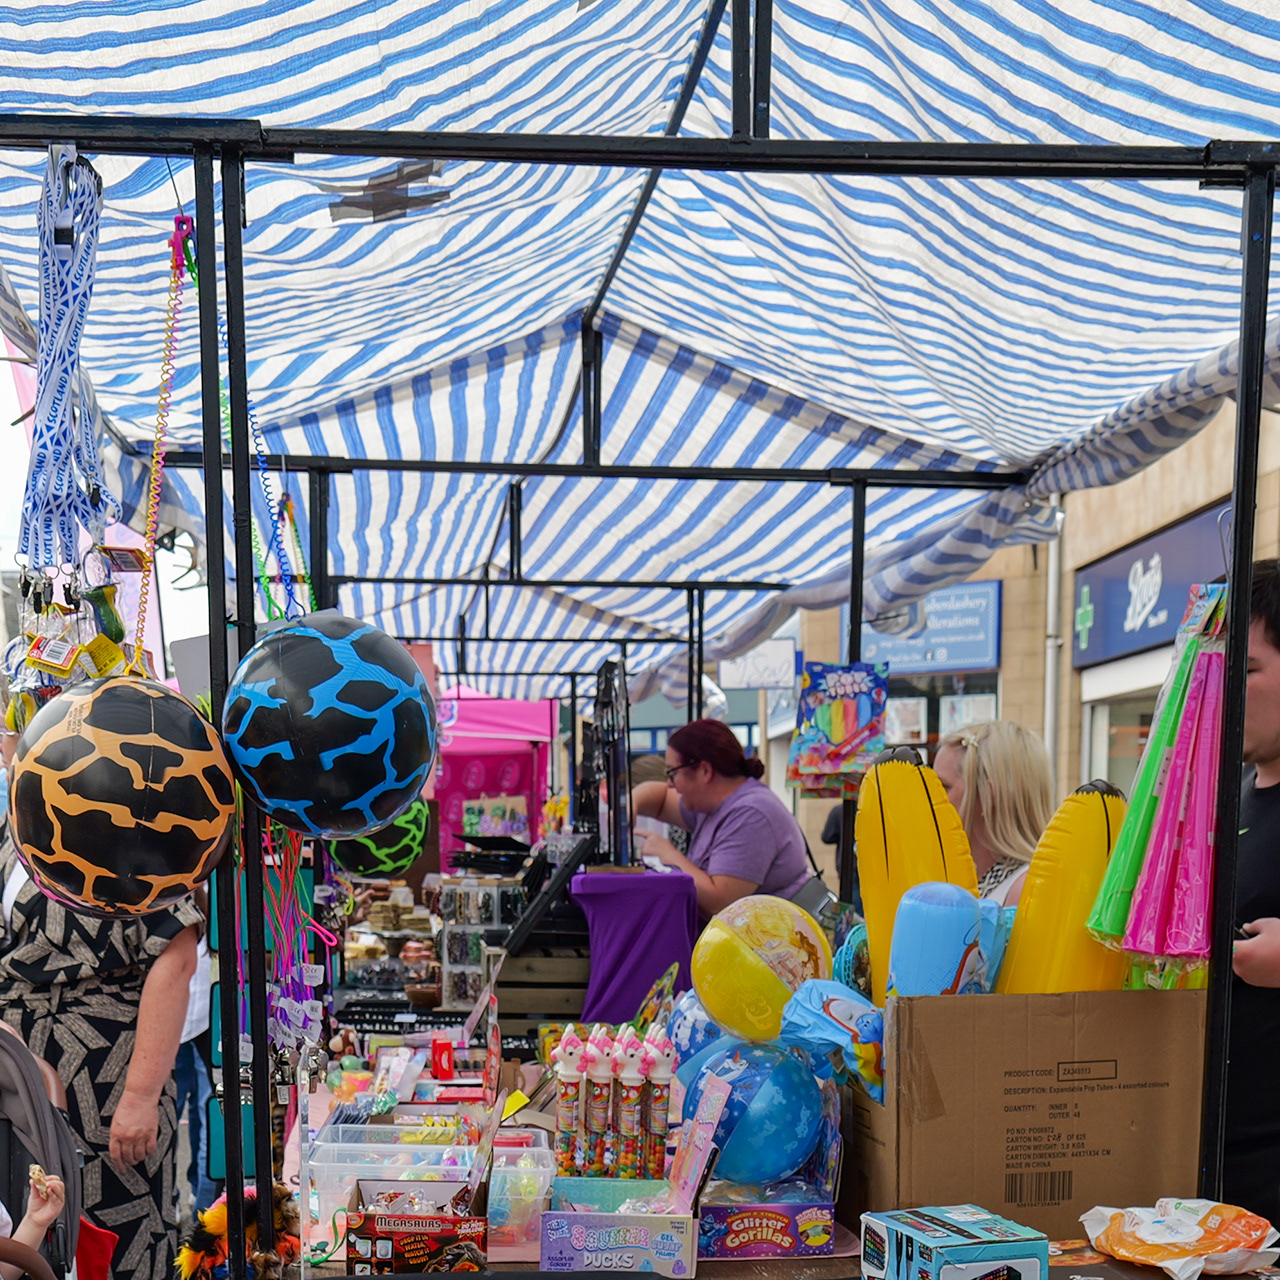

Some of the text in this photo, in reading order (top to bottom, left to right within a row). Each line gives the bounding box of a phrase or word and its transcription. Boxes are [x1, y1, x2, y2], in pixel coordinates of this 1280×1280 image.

[74, 236, 92, 283] SCOTLAND
[69, 300, 86, 349] SCOTLAND
[46, 308, 66, 358] SCOTLAND
[47, 375, 68, 424] SCOTLAND
[43, 516, 54, 565] SCOTLAND
[825, 671, 868, 688] POP
[1004, 1070, 1034, 1078] PRODUCT
[1004, 1087, 1047, 1095] DESCRIPTION:
[1049, 1085, 1083, 1094] Expandable
[1084, 1085, 1095, 1093] Pop
[1096, 1083, 1114, 1091] Tubes
[1004, 1104, 1037, 1112] QUANTITY:
[1048, 1103, 1068, 1111] INNER
[1048, 1111, 1071, 1119] OUTER
[1005, 1135, 1032, 1144] CARTON
[1005, 1144, 1032, 1152] CARTON
[1005, 1152, 1032, 1160] CARTON
[1005, 1161, 1023, 1169] MADE
[1032, 1160, 1052, 1168] CHINA
[731, 1218, 786, 1231] Glitter
[725, 1227, 793, 1248] Gorillas
[583, 1252, 634, 1269] DUCKS
